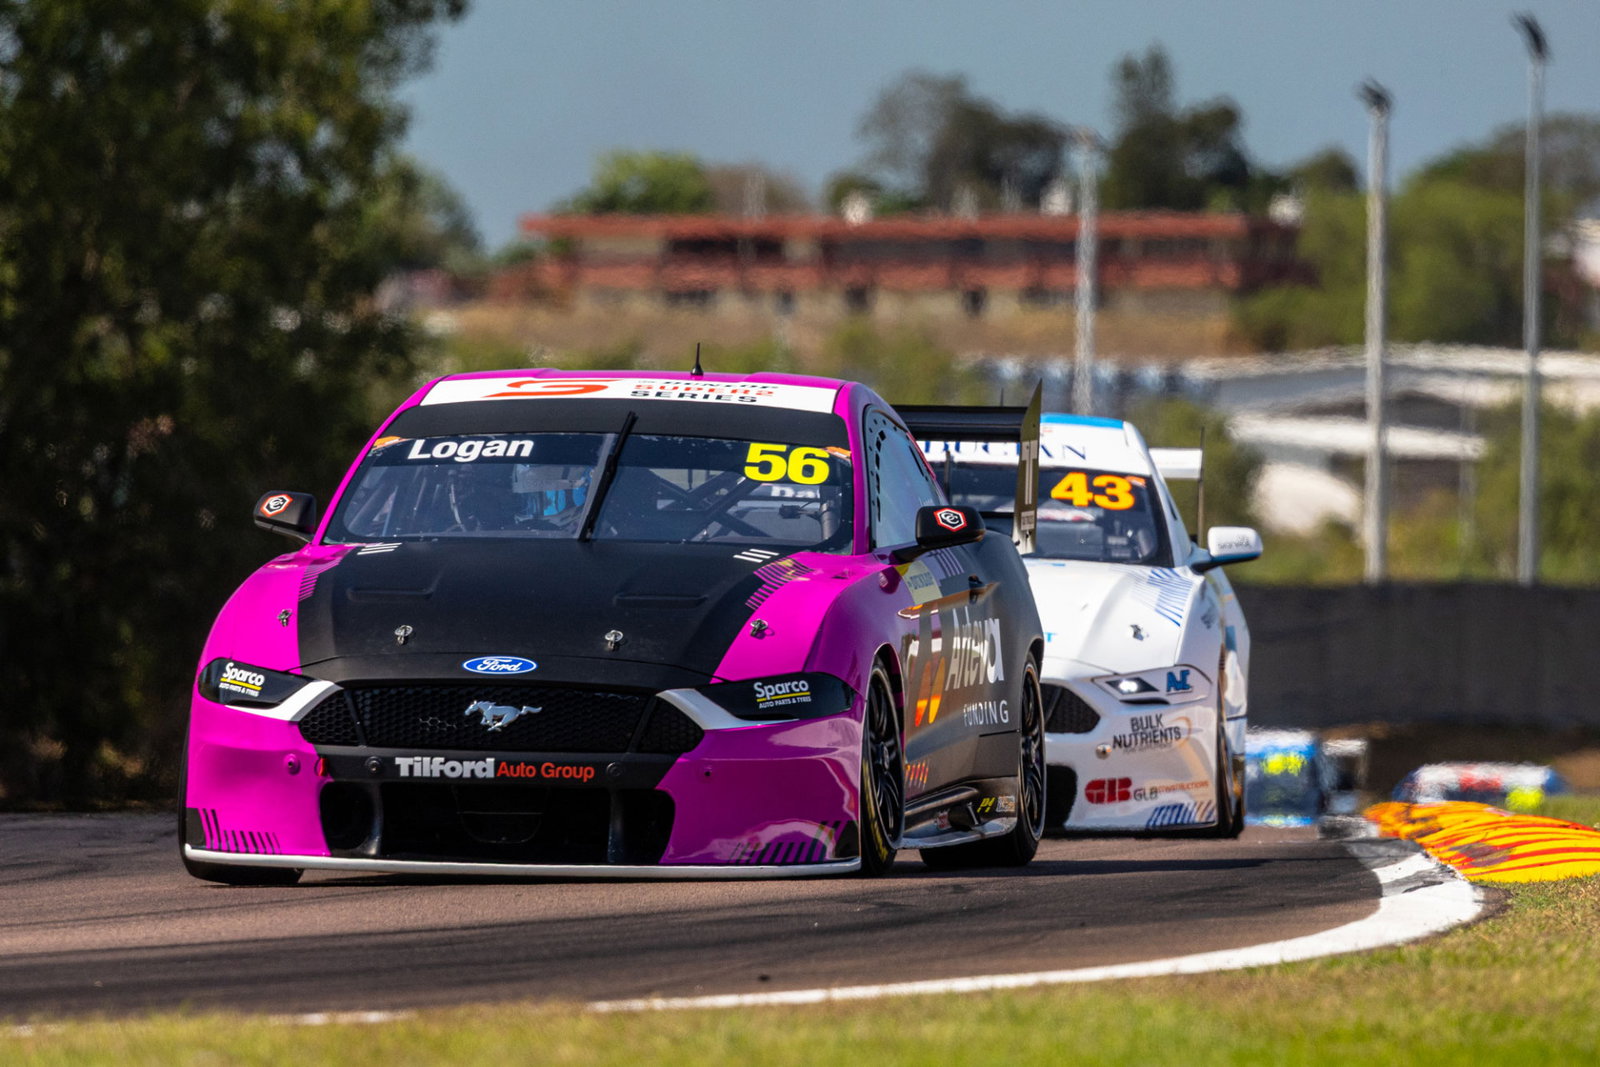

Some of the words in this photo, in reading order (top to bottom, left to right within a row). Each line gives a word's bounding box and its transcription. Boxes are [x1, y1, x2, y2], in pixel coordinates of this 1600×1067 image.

[631, 390, 758, 403] SERIES
[634, 384, 774, 397] SUPER2
[407, 438, 535, 463] Logan
[744, 442, 831, 485] 56
[1050, 471, 1136, 511] 43
[222, 662, 265, 686] Sparco
[476, 658, 523, 671] Ford
[753, 680, 809, 700] Sparco
[759, 701, 774, 709] AUTO
[1130, 712, 1164, 733] BULK
[1113, 725, 1182, 749] NUTRIENTS
[395, 756, 496, 778] Tilford
[497, 761, 538, 778] Auto
[540, 762, 596, 783] Group
